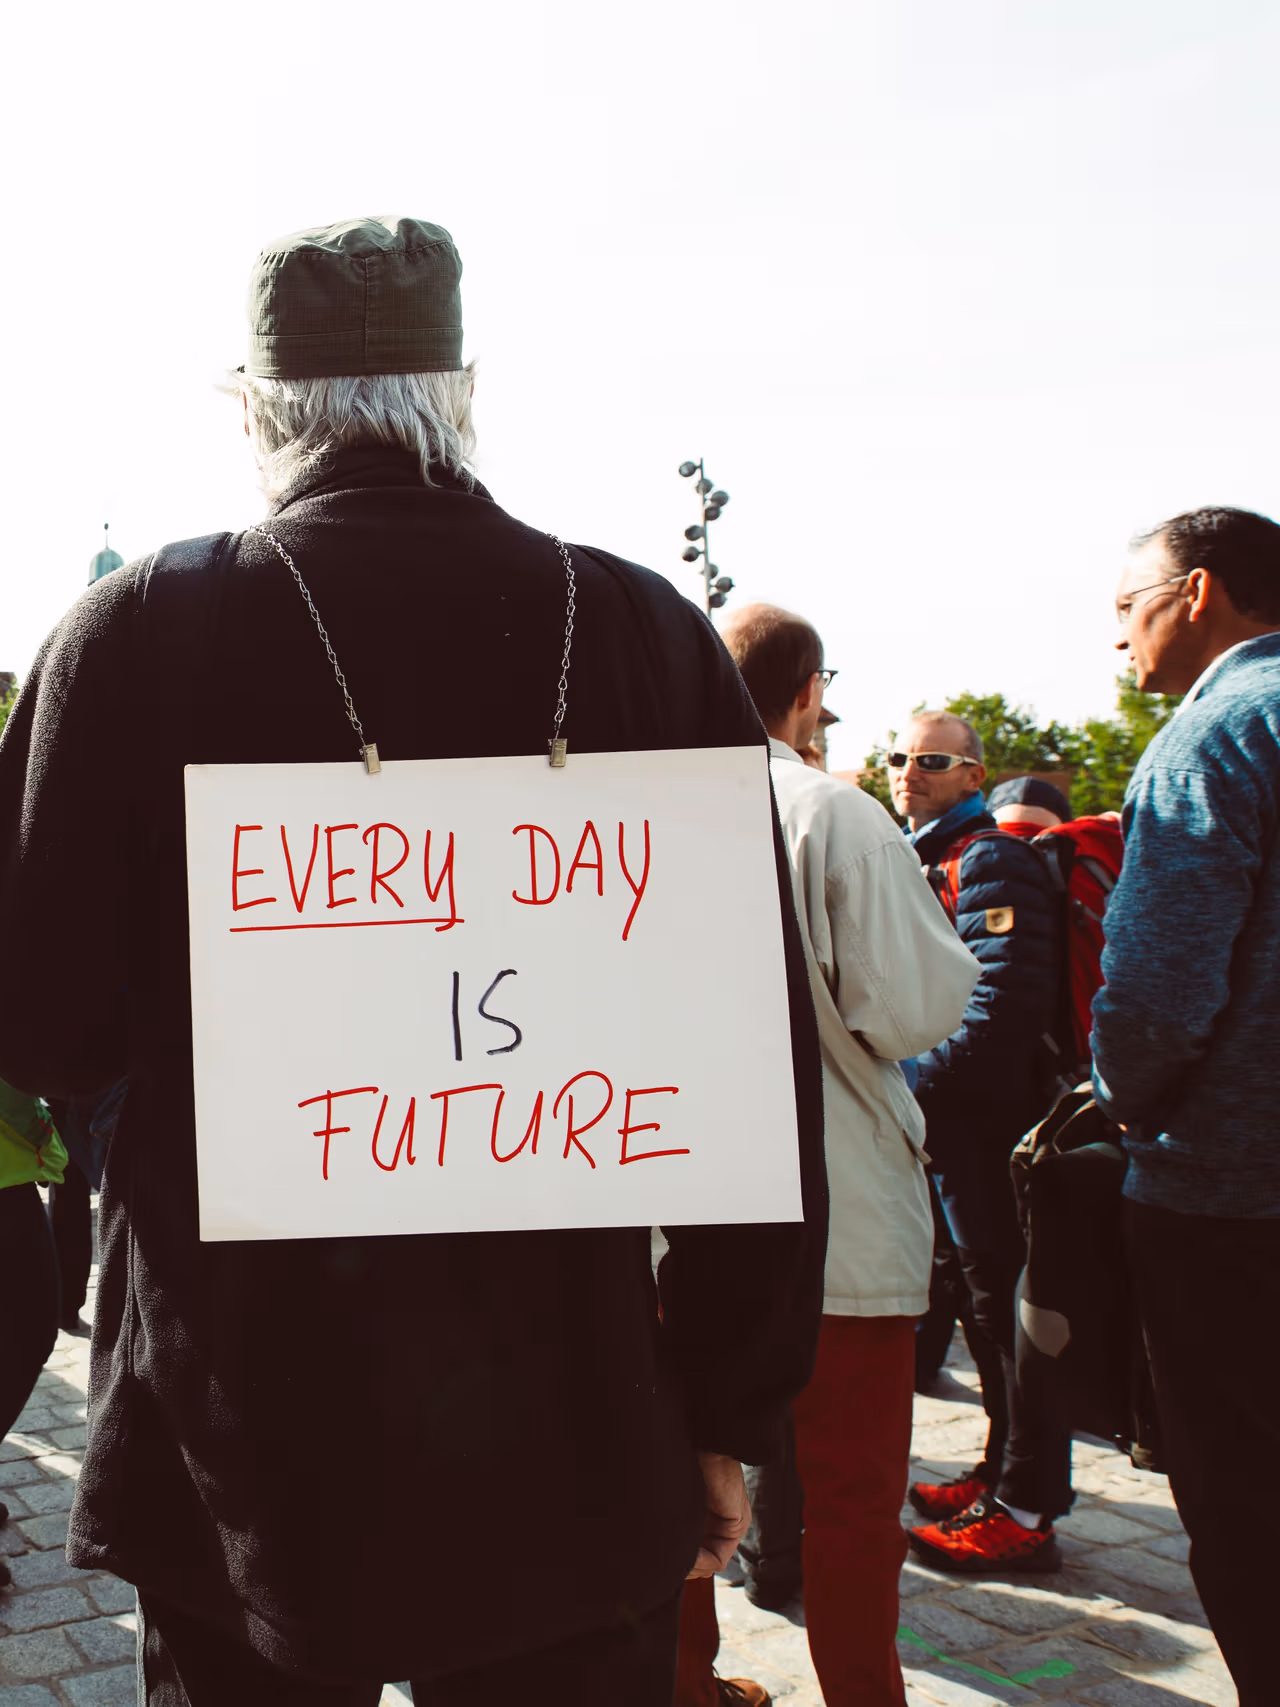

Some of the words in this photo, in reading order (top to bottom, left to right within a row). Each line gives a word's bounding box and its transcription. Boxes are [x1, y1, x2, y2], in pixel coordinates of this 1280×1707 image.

[230, 822, 465, 932] EVERY
[512, 819, 651, 941] DAY
[451, 968, 523, 1061] IS
[297, 1070, 691, 1181] FUTURE
